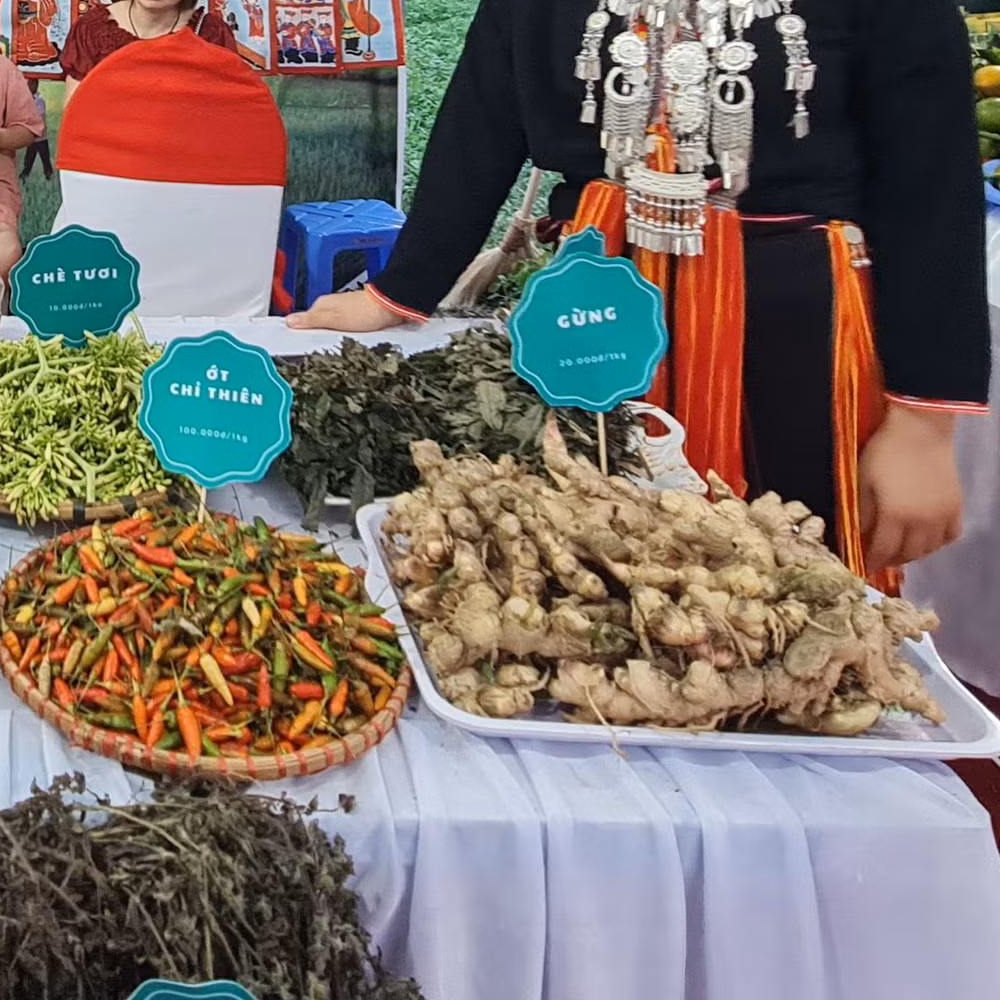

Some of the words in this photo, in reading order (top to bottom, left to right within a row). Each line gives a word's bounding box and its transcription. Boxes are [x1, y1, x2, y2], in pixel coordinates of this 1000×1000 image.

[32, 268, 66, 285] CHÈ
[73, 267, 118, 282] TƯƠI
[556, 306, 617, 330] GỪNG
[206, 363, 229, 382] ỚT
[207, 383, 264, 406] THIÊN
